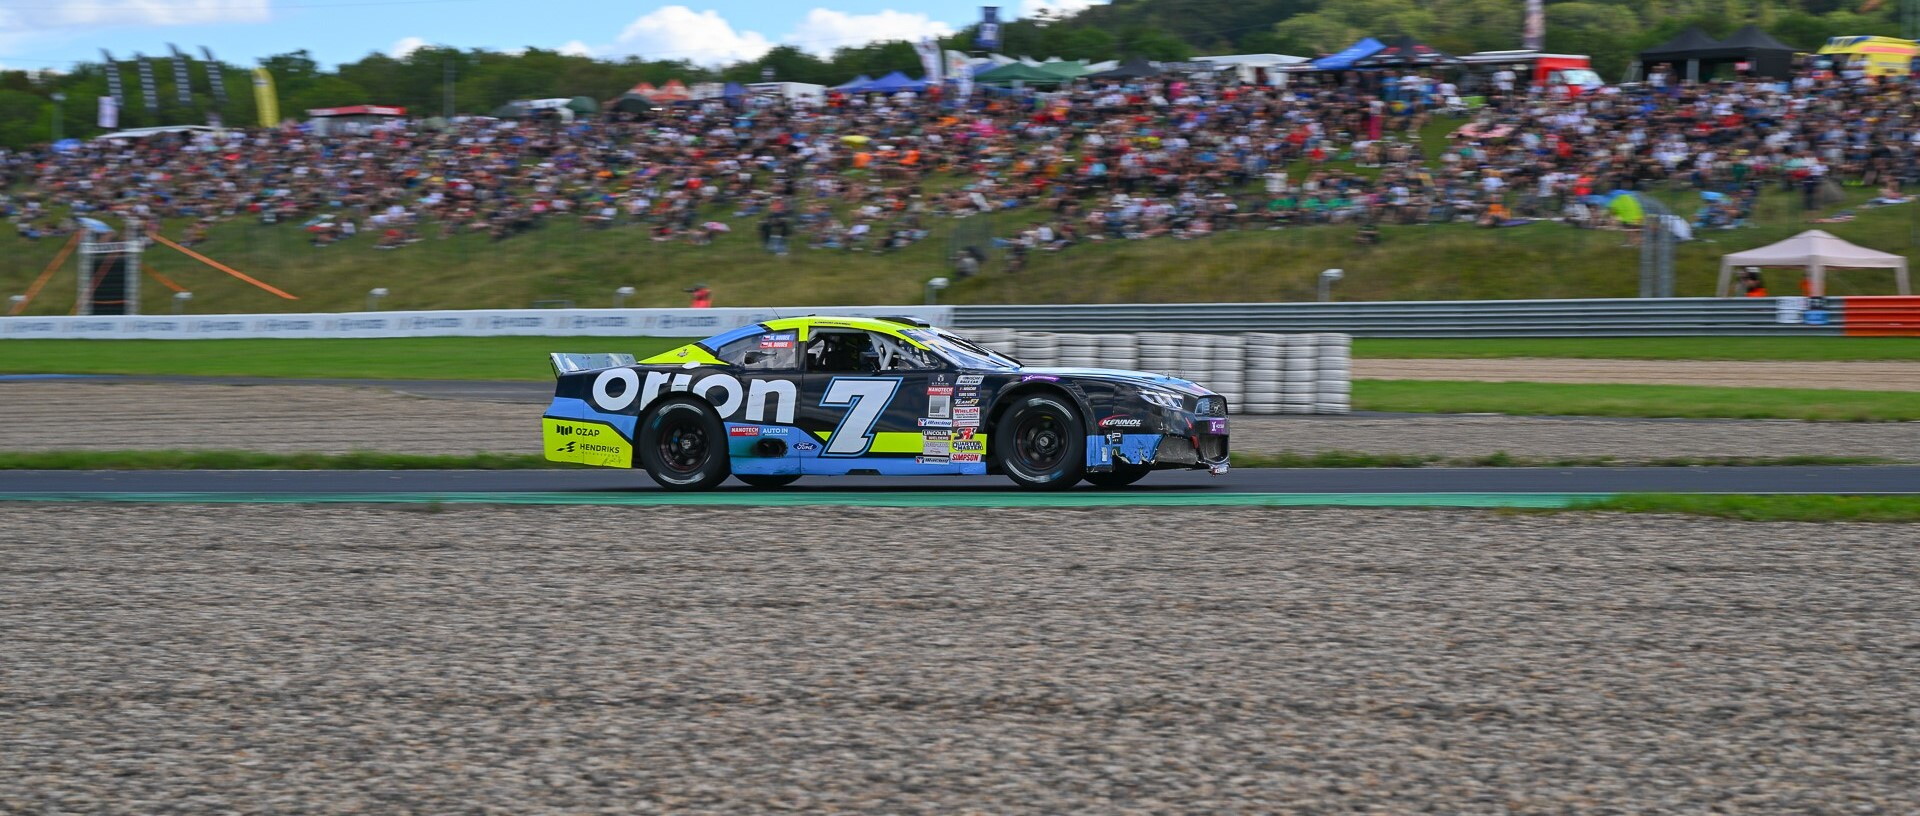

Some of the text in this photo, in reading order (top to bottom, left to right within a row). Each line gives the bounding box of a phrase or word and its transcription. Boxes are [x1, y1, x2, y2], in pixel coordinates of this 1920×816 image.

[592, 361, 798, 424] orion
[576, 428, 600, 436] OZAP
[819, 376, 903, 458] 7
[580, 444, 620, 453] HENDRIKS
